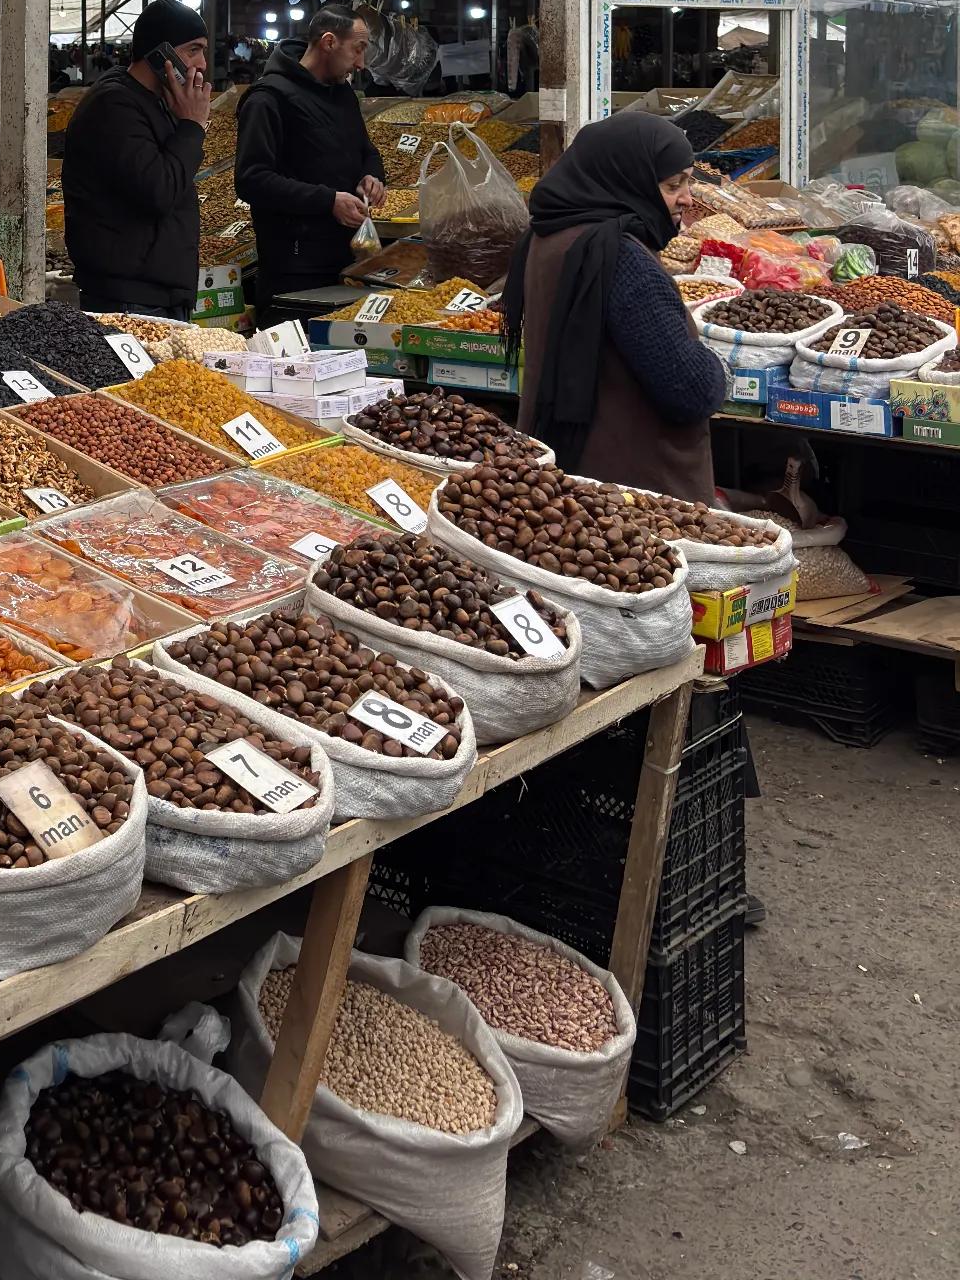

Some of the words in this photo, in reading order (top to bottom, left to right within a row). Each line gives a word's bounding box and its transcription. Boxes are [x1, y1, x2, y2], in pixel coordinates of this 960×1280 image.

[400, 136, 418, 147] 22
[907, 250, 918, 271] 14
[367, 296, 390, 314] 10
[457, 291, 485, 311] 12
[358, 313, 379, 321] man
[840, 330, 861, 349] 9
[120, 342, 140, 363] 8
[12, 378, 38, 391] 13
[235, 420, 262, 442] 11
[252, 442, 281, 459] man.
[39, 493, 69, 509] 13
[385, 493, 412, 517] 8
[169, 559, 206, 575] 12
[189, 573, 226, 588] man.
[513, 613, 544, 645] 8
[361, 698, 413, 730] 8
[407, 719, 438, 746] man
[229, 753, 260, 779] 7
[28, 786, 52, 810] 6
[261, 777, 303, 805] man.
[40, 814, 90, 847] man.
